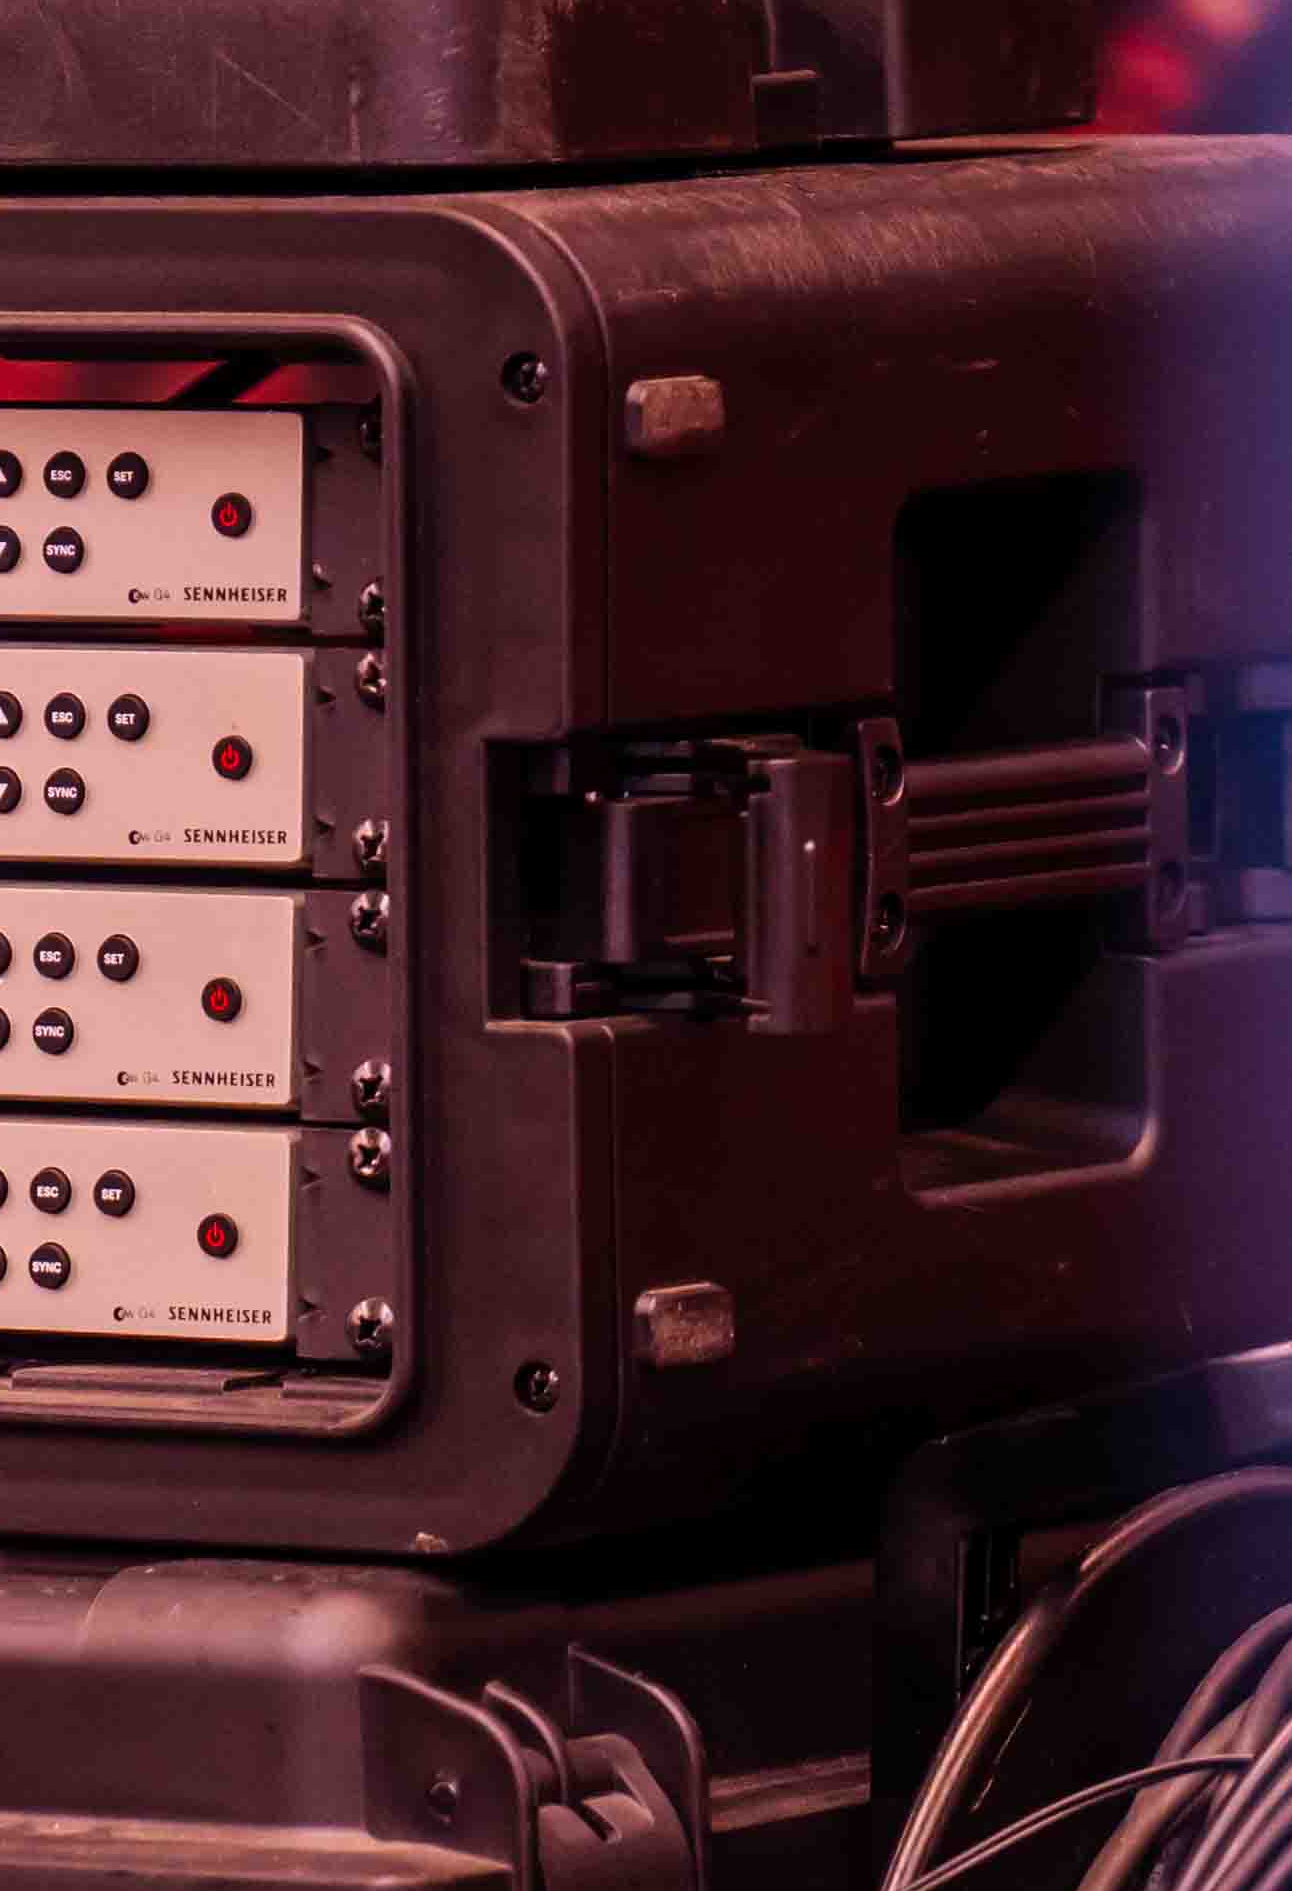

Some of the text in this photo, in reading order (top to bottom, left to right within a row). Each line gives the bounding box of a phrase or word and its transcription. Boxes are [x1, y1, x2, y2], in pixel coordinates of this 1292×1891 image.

[51, 470, 72, 481] ESC
[114, 471, 133, 482] SET
[46, 545, 75, 556] SYNC
[184, 587, 286, 602] SENNHEISER
[52, 712, 73, 723] ESC
[115, 713, 135, 724] SET
[48, 787, 77, 798] SYNC
[184, 829, 287, 844] SENNHEISER
[40, 951, 61, 962] ESC
[104, 953, 124, 964] SET
[35, 1025, 64, 1037] SYNC
[173, 1070, 275, 1086] SENNHEISER
[37, 1186, 59, 1198] ESC
[102, 1188, 122, 1200] SET
[32, 1261, 61, 1273] SYNC
[168, 1307, 271, 1324] SENNHEISER
